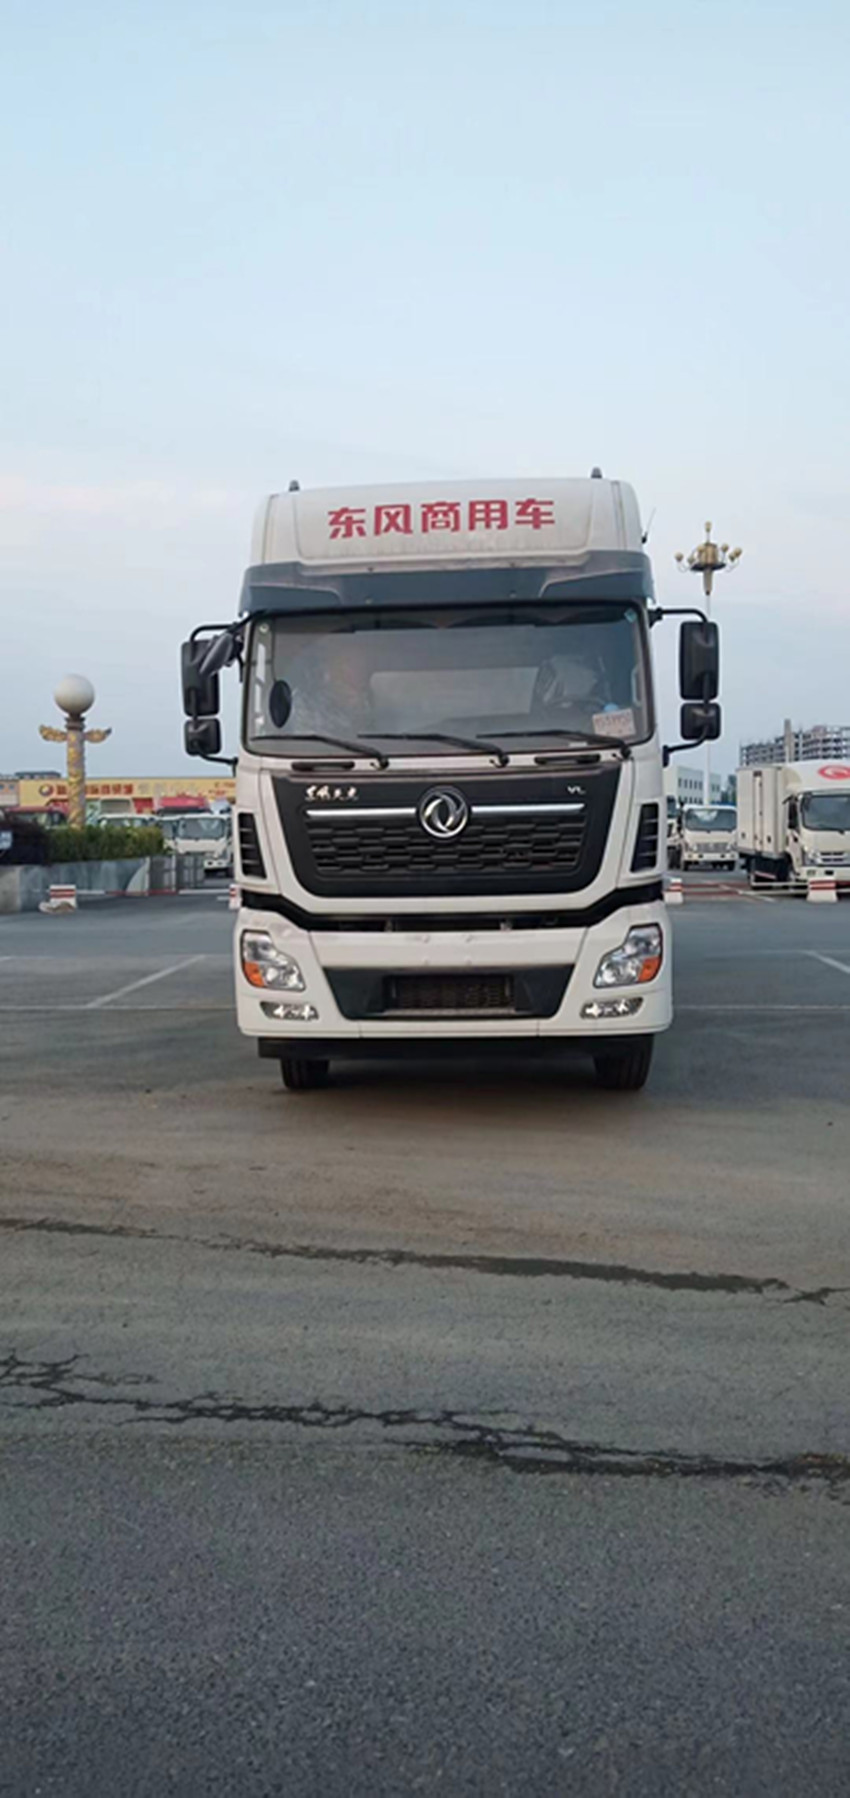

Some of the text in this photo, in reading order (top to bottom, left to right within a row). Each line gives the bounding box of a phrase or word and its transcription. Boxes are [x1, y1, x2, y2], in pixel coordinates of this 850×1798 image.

[328, 498, 555, 539] 东风商用车
